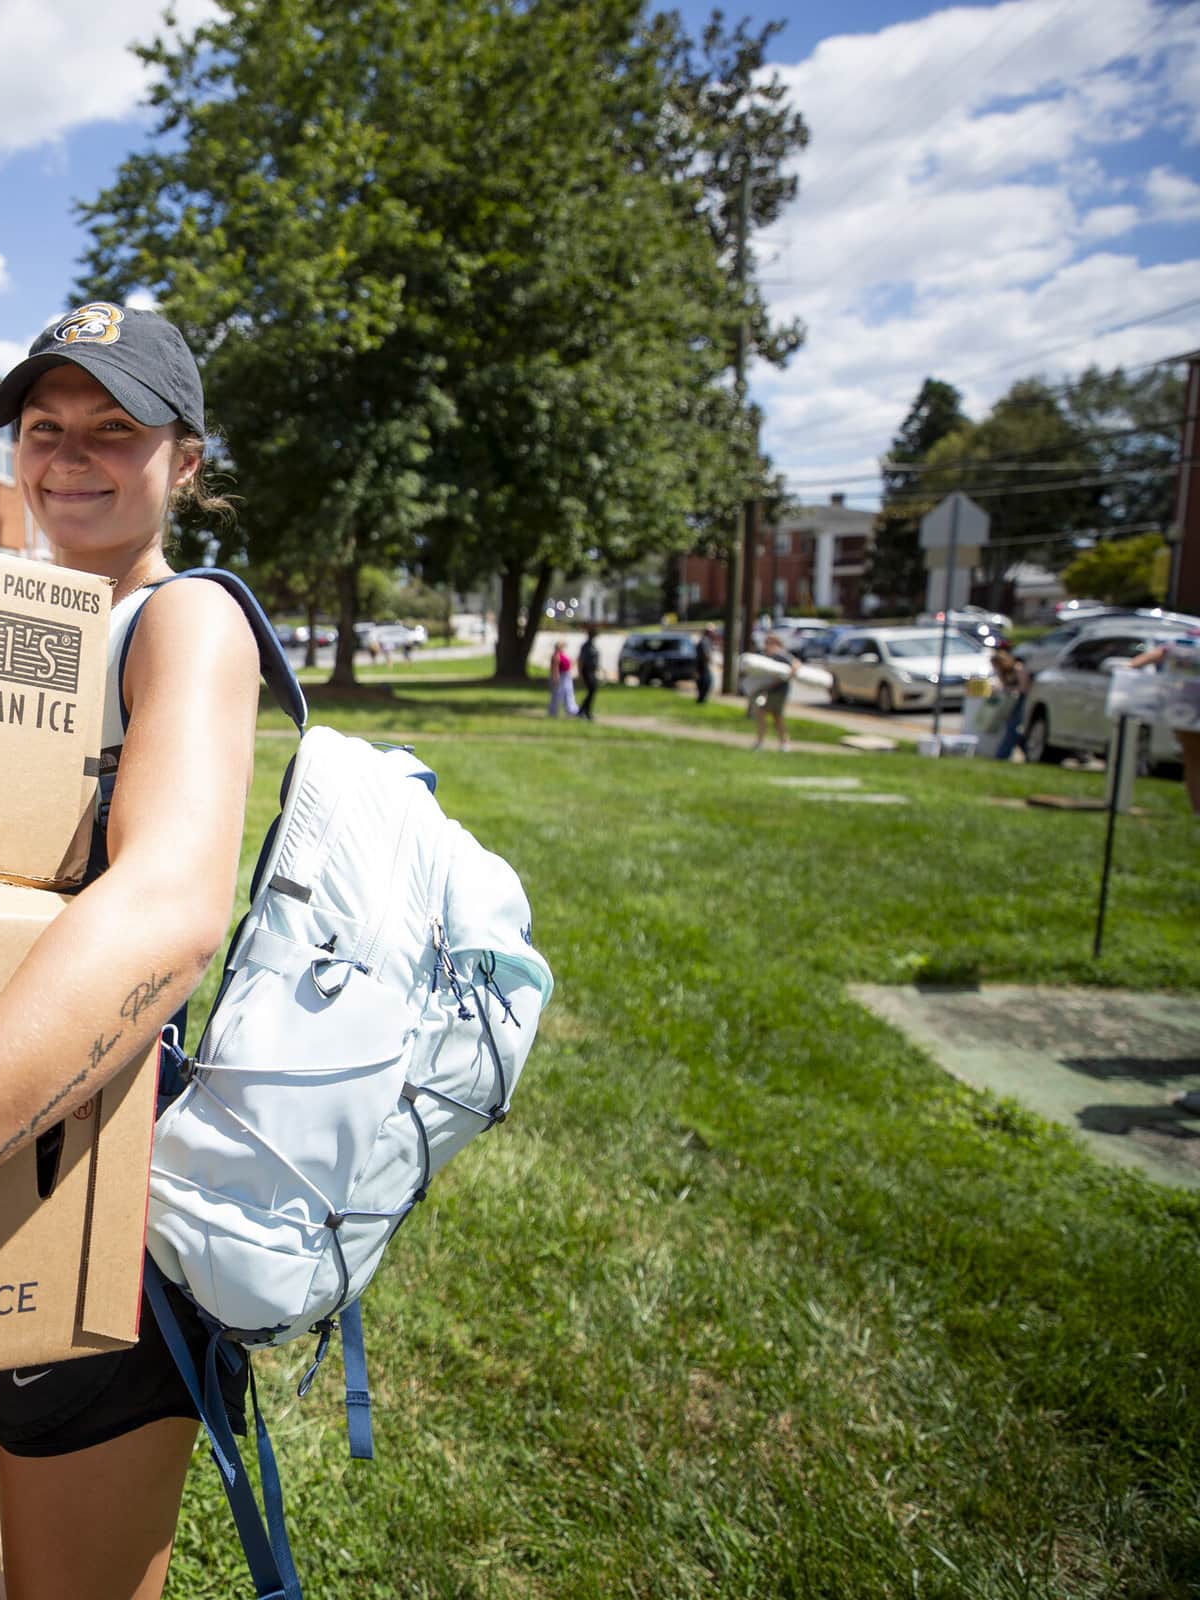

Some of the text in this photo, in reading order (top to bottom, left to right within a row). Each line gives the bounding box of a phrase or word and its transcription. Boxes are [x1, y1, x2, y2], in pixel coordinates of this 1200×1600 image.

[3, 574, 47, 603] PACK
[50, 584, 100, 615] BOXES
[36, 692, 77, 734] ICE
